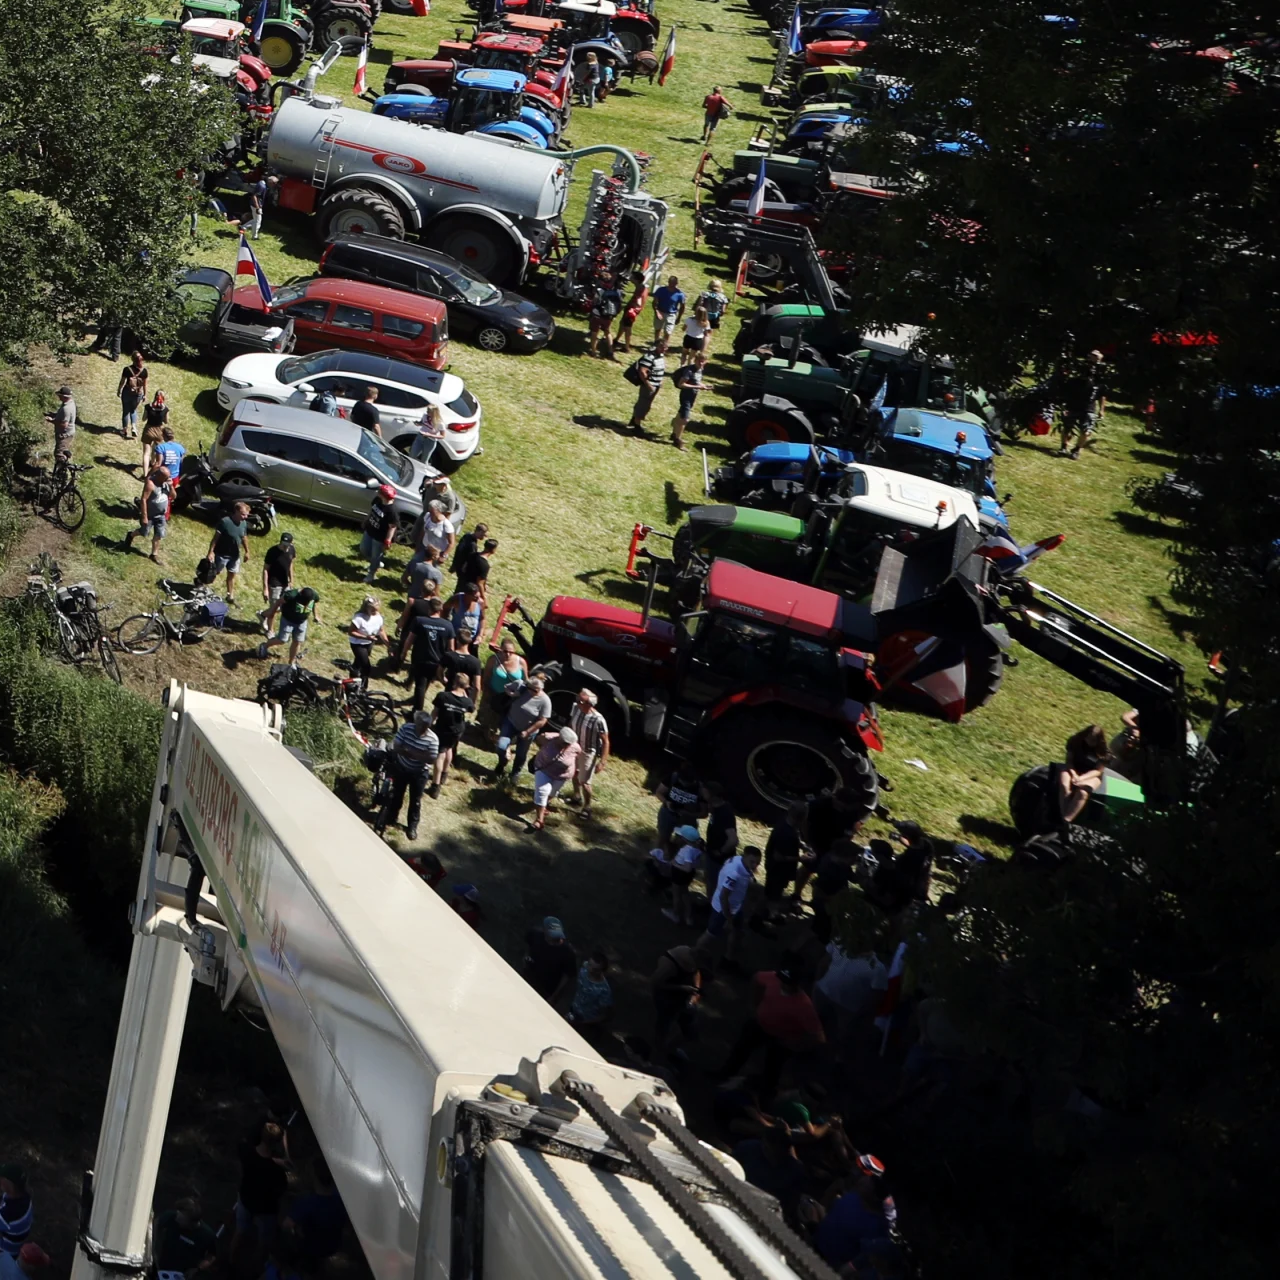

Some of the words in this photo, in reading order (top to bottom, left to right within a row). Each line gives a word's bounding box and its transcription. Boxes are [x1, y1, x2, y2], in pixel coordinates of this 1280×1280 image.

[388, 158, 410, 169] JAKO
[720, 599, 764, 618] MAXXTRAC
[185, 732, 201, 799] DE
